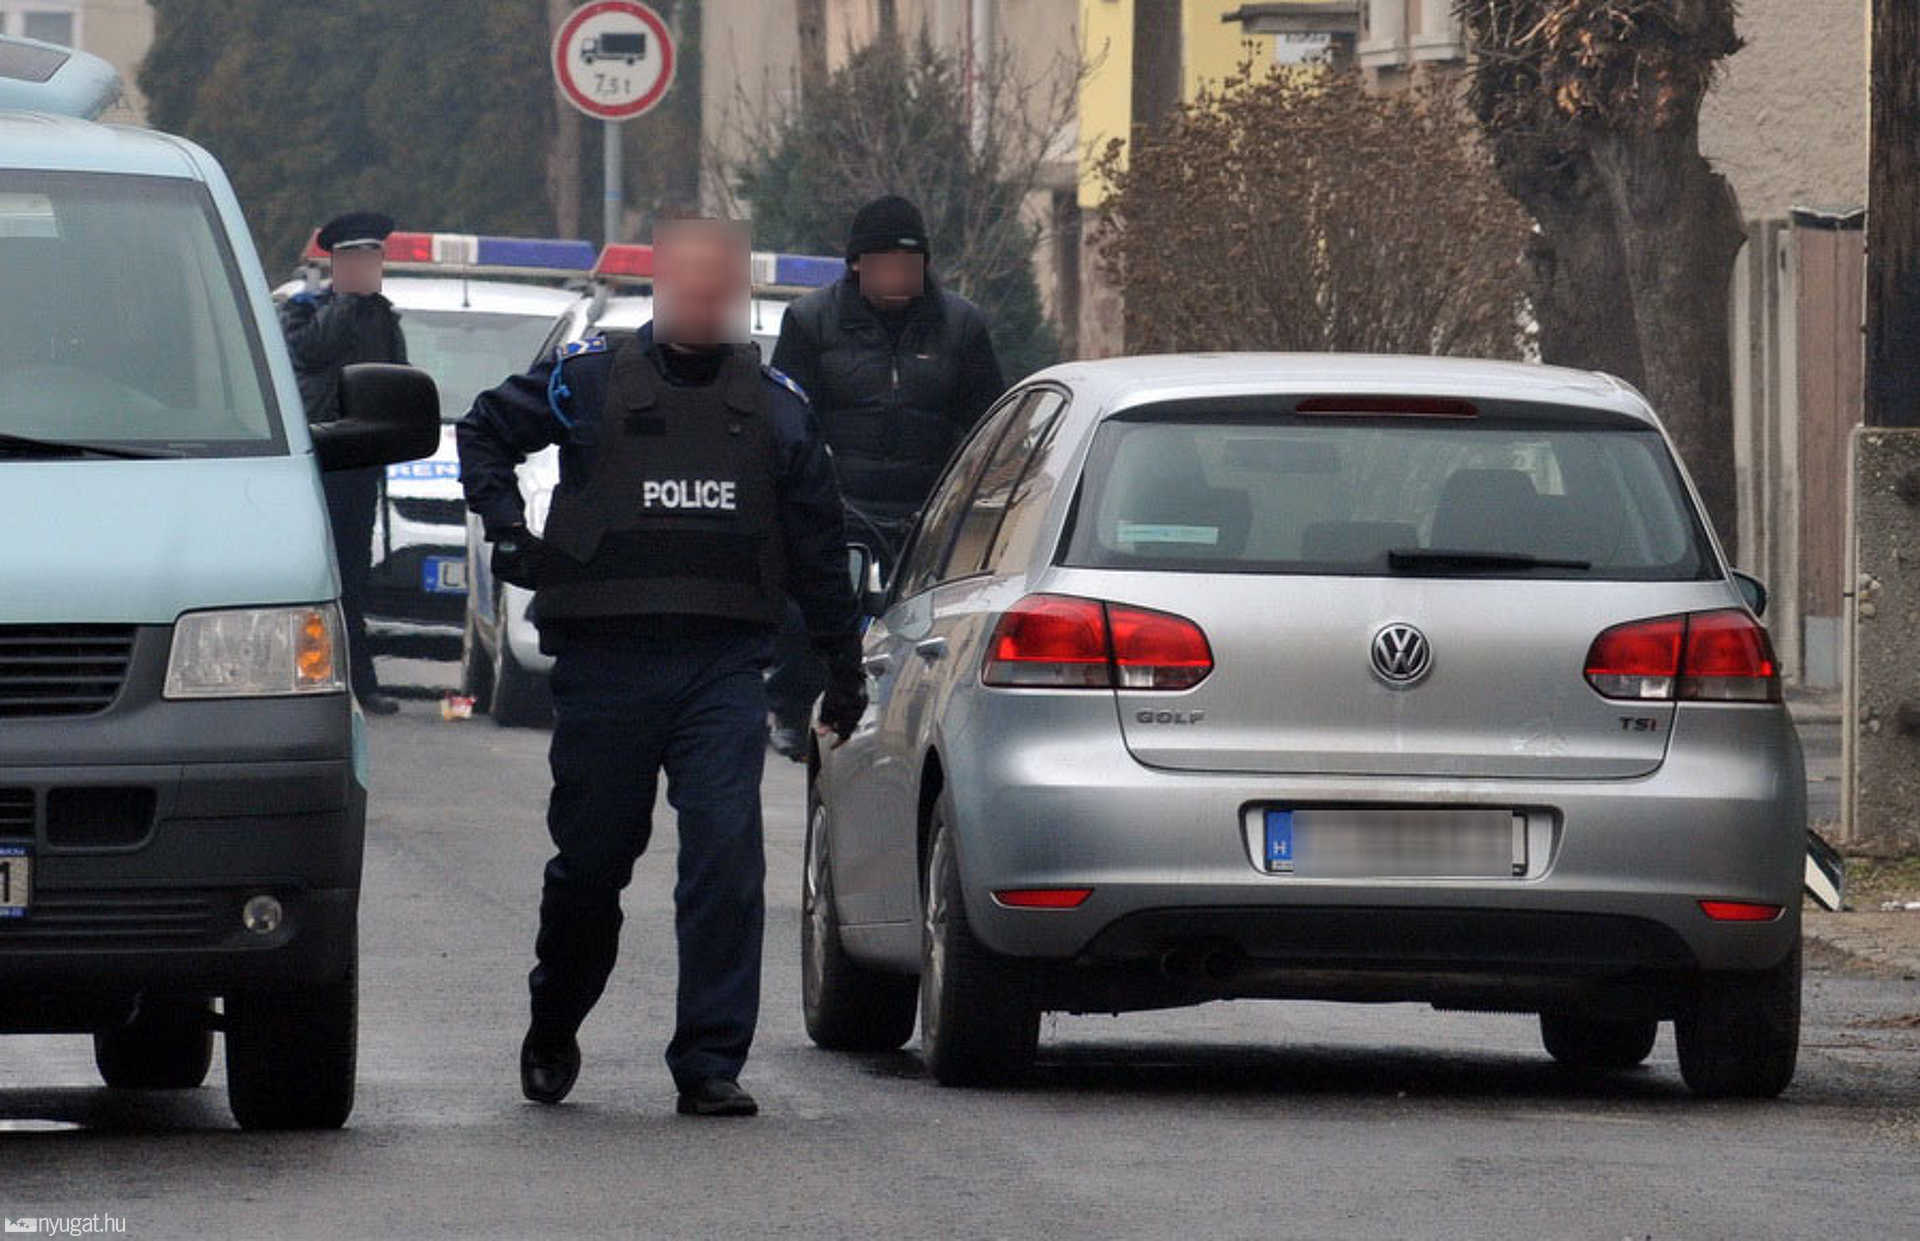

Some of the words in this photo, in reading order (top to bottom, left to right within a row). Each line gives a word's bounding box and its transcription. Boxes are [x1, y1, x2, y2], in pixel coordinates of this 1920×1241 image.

[643, 479, 736, 509] POLICE
[1375, 625, 1426, 677] VW
[1136, 710, 1205, 725] GOLF
[1272, 841, 1288, 856] H
